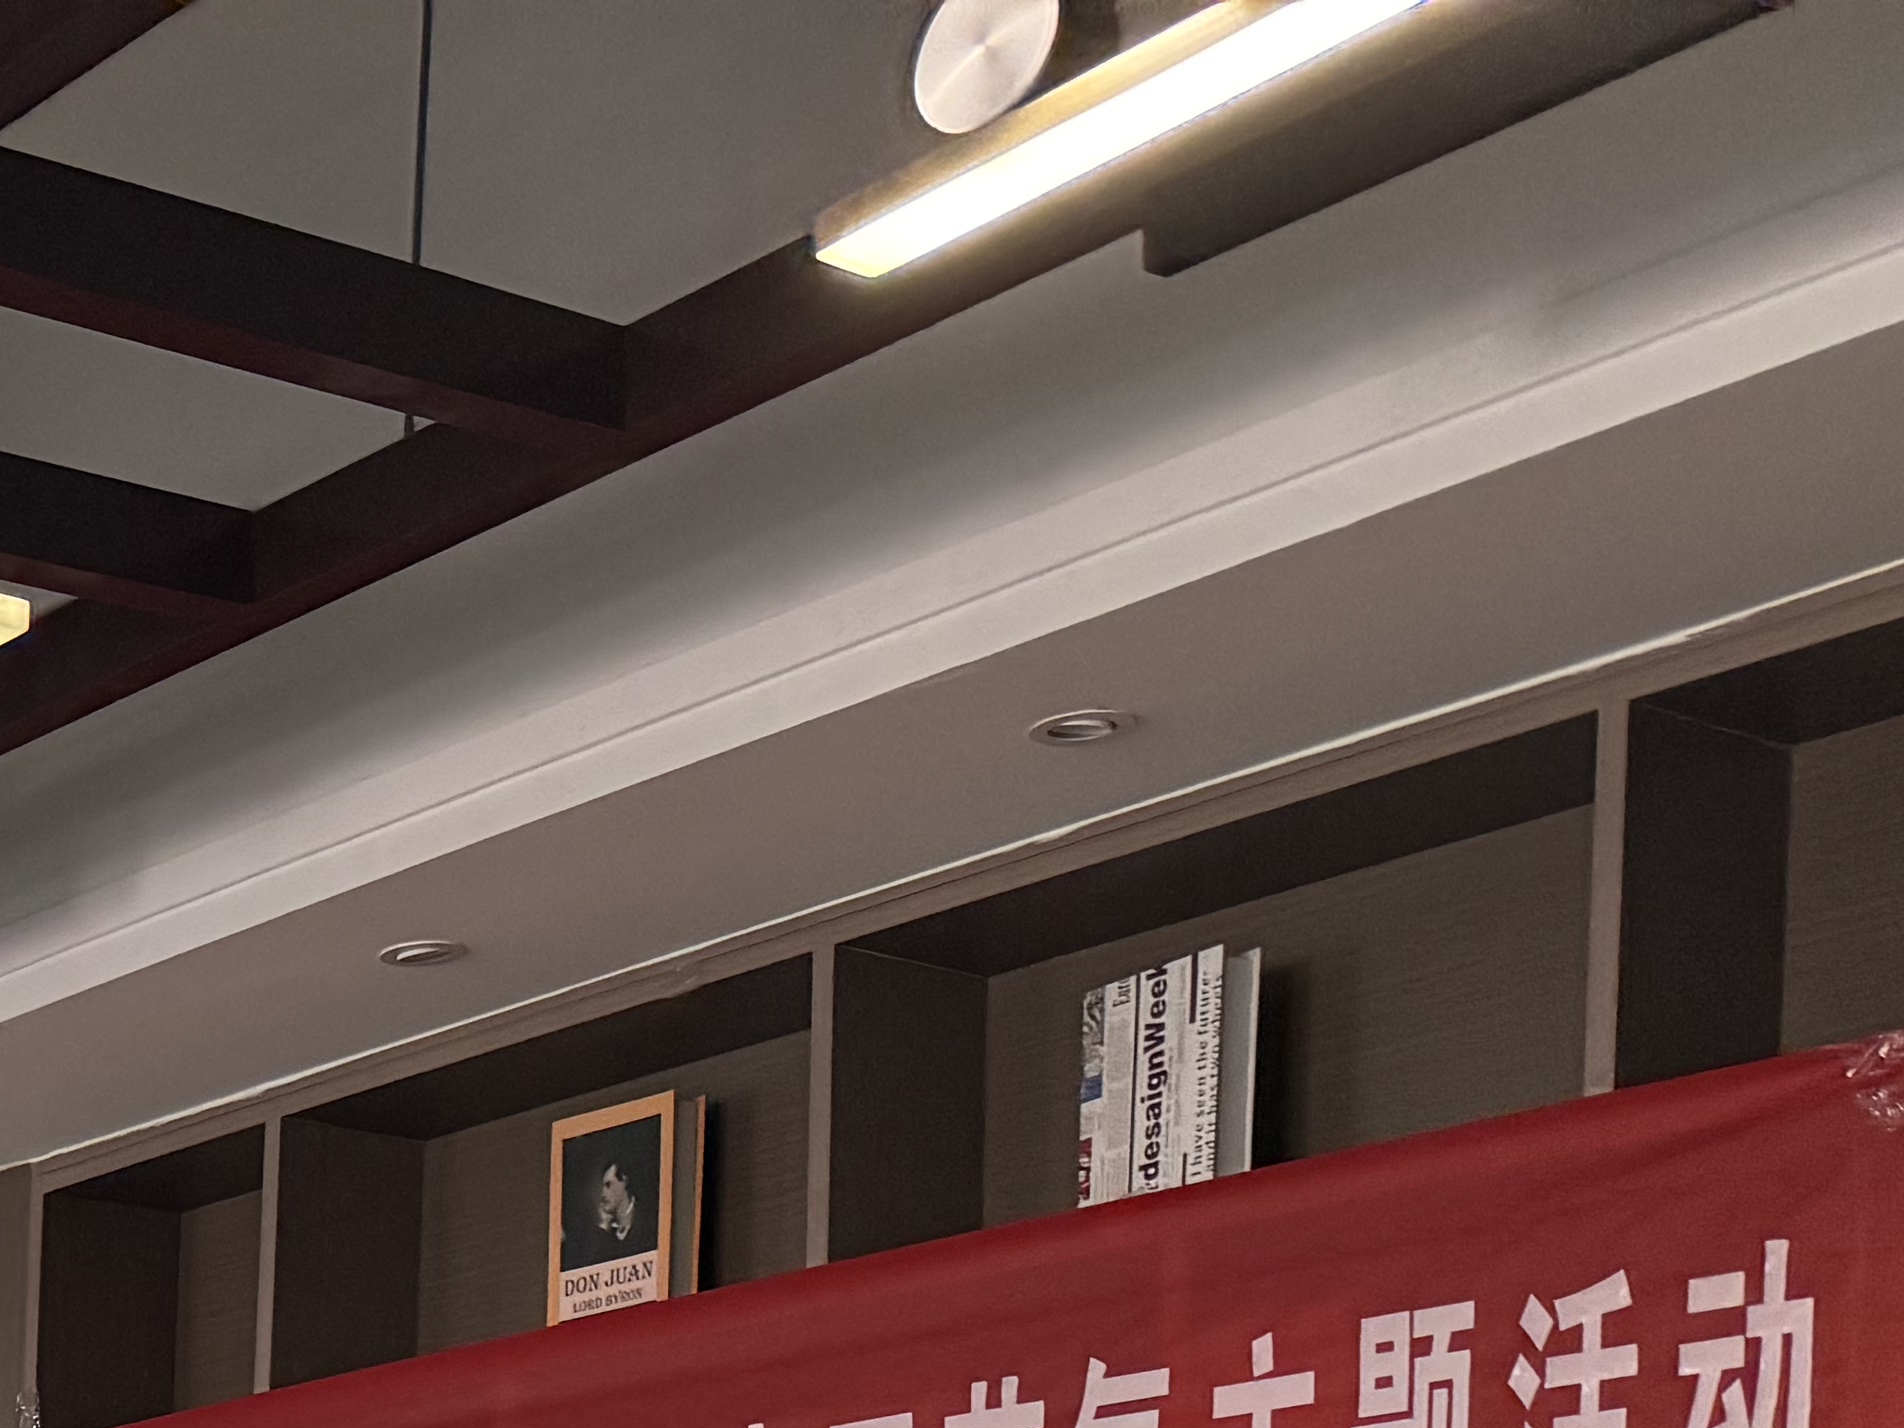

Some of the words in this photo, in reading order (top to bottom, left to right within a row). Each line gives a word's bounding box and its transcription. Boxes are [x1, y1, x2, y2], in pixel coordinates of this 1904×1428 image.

[565, 1272, 600, 1297] DON
[604, 1260, 654, 1288] JUAN
[572, 1297, 603, 1313] LORD
